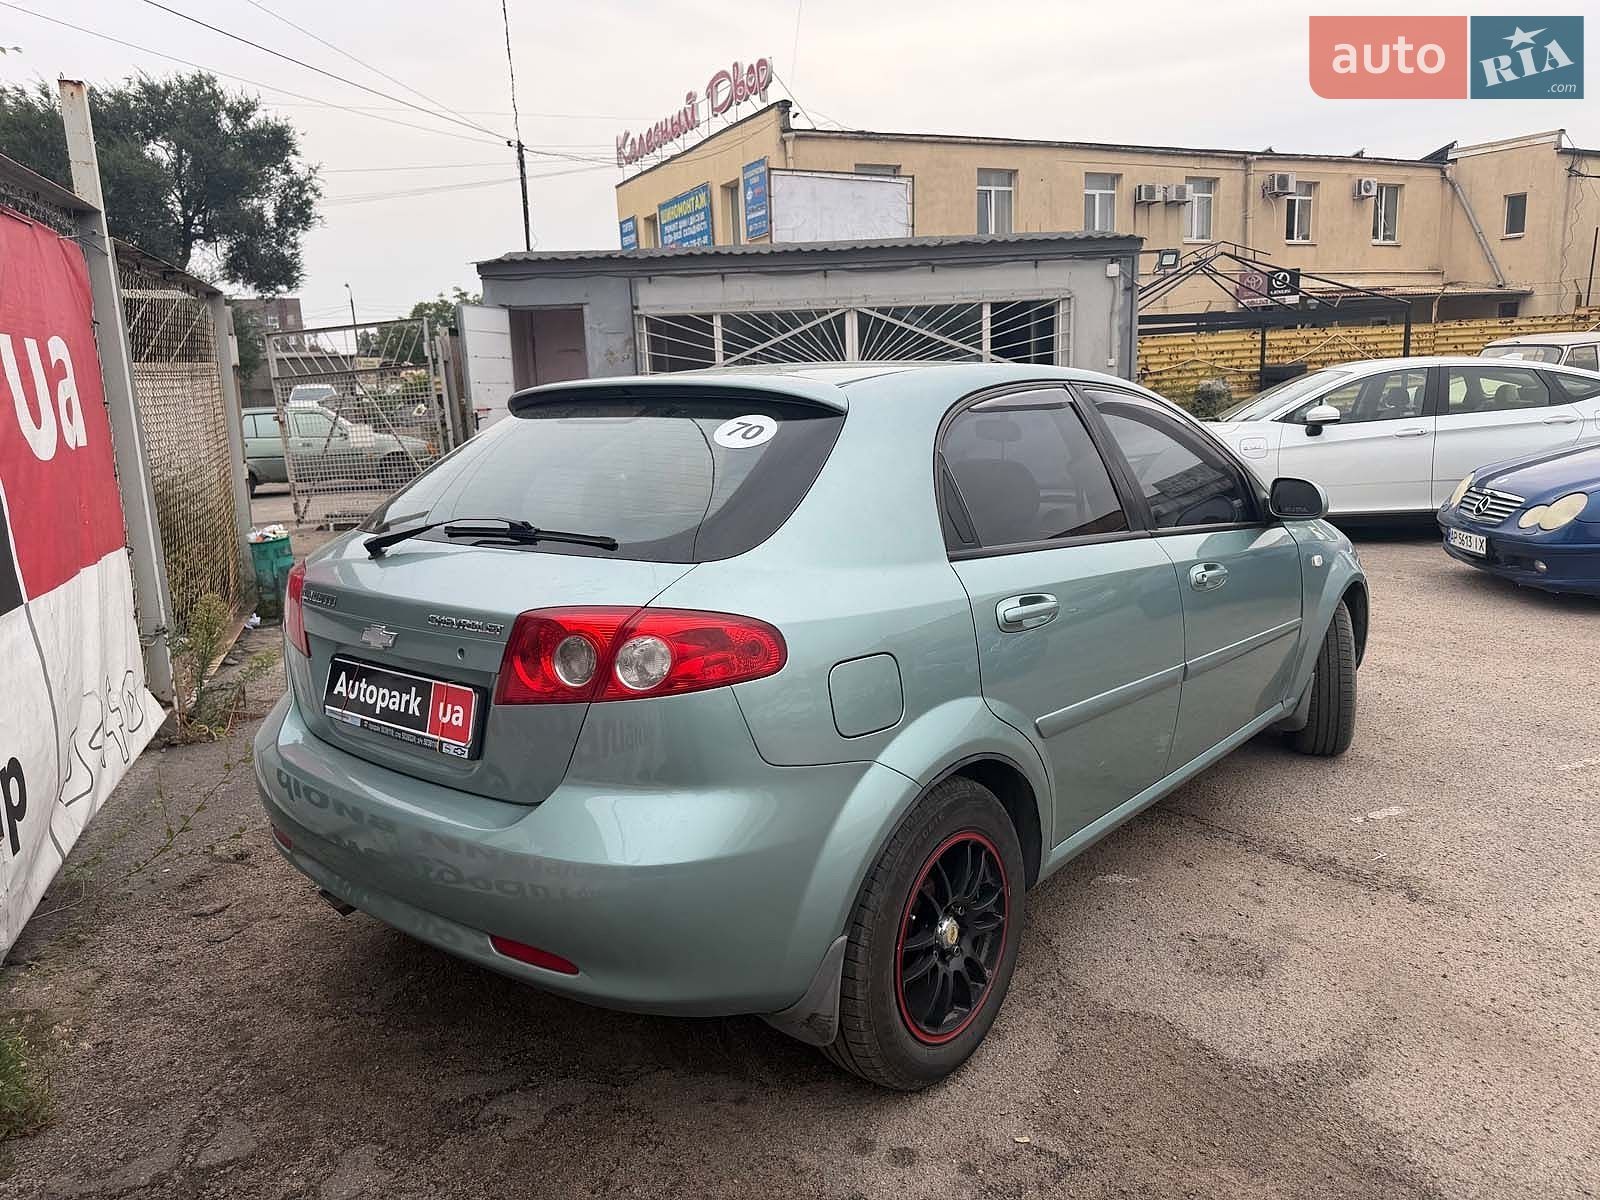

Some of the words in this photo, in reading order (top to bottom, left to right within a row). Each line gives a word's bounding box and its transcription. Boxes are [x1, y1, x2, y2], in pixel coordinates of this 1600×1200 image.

[727, 422, 764, 439] 70
[333, 671, 422, 717] Autopark
[438, 701, 464, 727] ua
